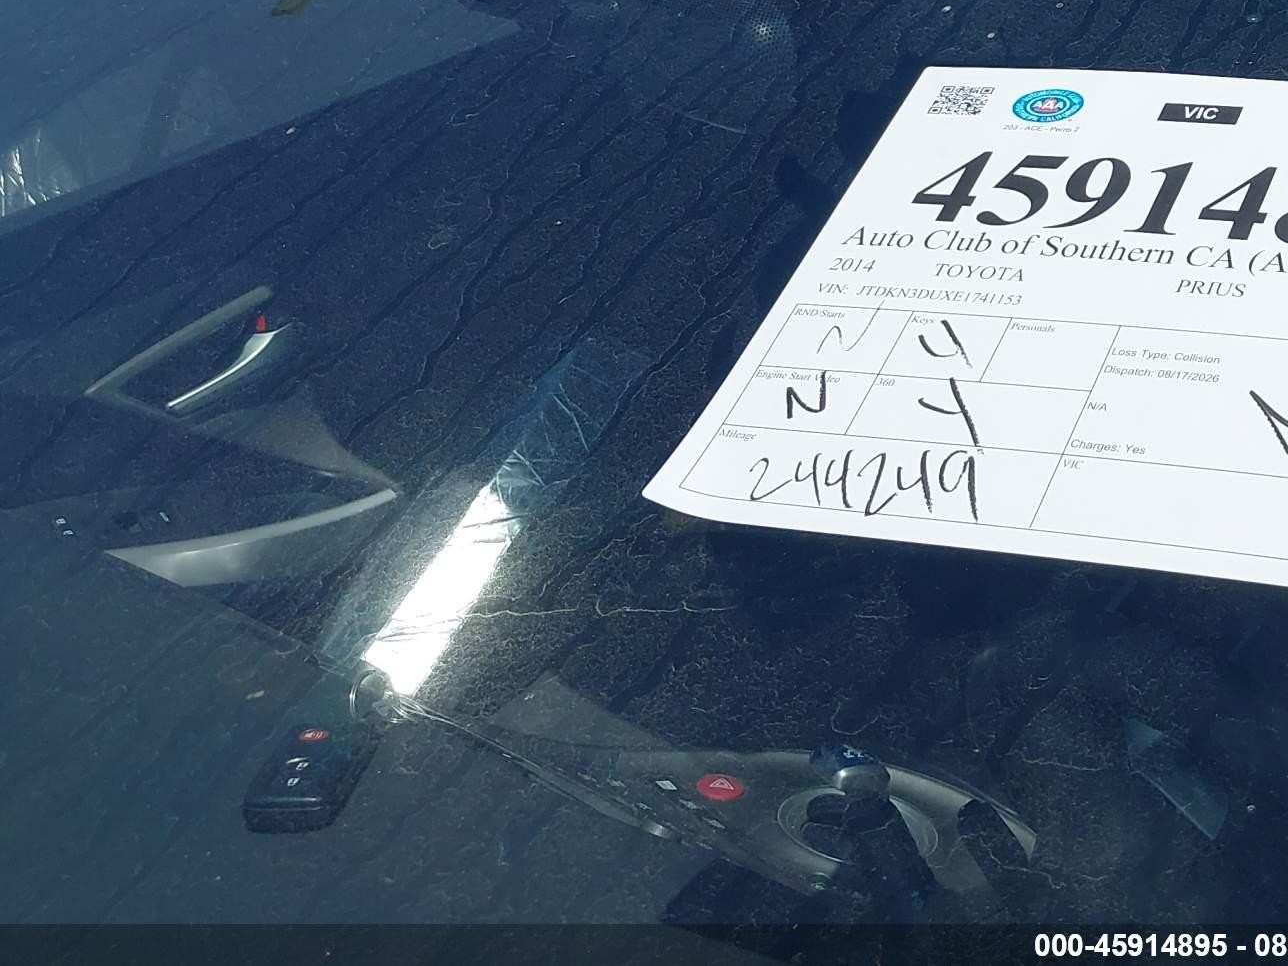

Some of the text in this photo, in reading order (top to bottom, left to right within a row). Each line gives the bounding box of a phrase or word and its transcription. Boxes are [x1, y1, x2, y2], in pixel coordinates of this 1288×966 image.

[1032, 97, 1064, 110] AAA
[1184, 105, 1220, 121] VIC
[841, 226, 914, 249] Auto
[923, 229, 993, 253] Club
[1001, 234, 1041, 255] of
[1040, 235, 1175, 265] Southern
[1186, 245, 1235, 270] CA
[828, 257, 1247, 298] 2014 TOYOTA PRIUS
[818, 283, 1023, 306] VIN: JTDKN3DUXE1741153
[911, 314, 935, 325] Keys
[1010, 321, 1056, 334] Personals
[1111, 347, 1221, 365] Loss Type: Collision
[788, 371, 812, 381] Start
[1103, 365, 1221, 384] Dispatch: 08/17/2026
[875, 377, 897, 387] 360
[1087, 401, 1108, 412] N/A
[718, 427, 758, 441] Mileage
[1070, 438, 1147, 455] Charges: Yes
[1063, 458, 1085, 470] VIC
